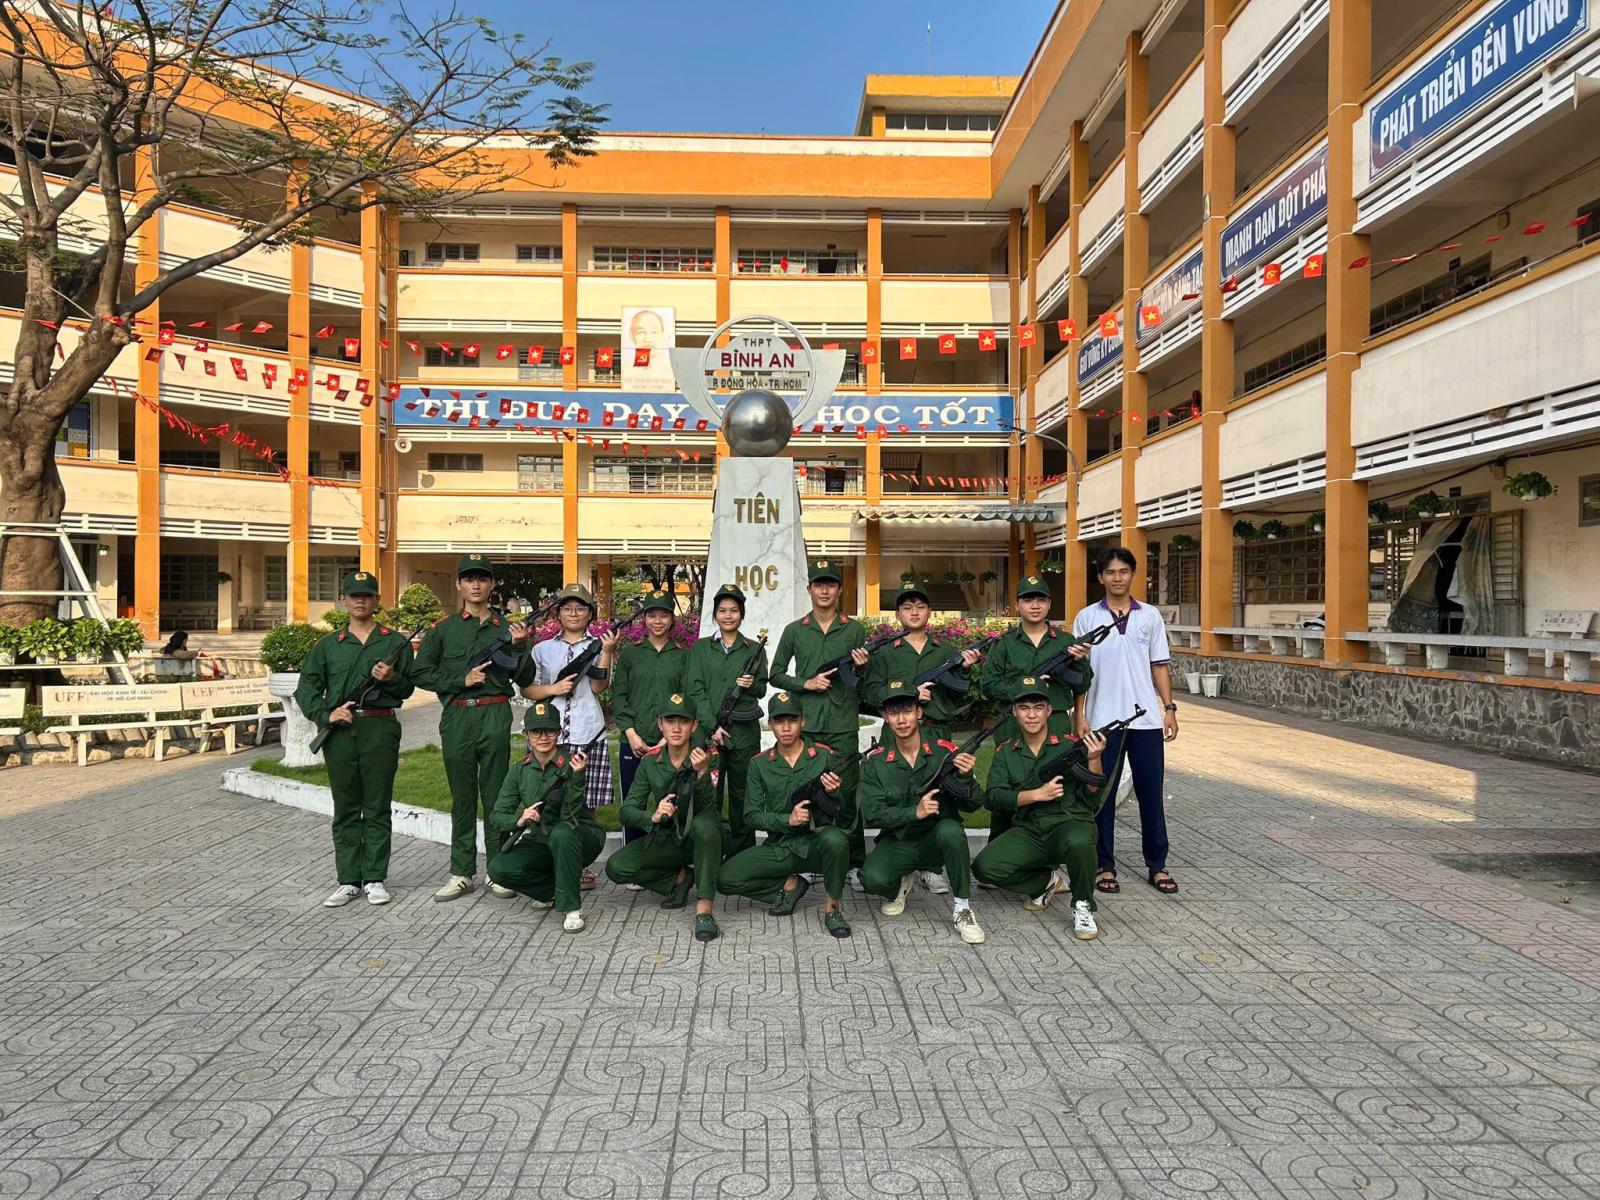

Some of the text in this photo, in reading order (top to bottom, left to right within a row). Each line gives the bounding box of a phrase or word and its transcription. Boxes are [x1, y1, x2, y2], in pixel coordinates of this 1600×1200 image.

[1380, 94, 1416, 153] PHÁT
[1420, 49, 1465, 123] TRIỂN
[1472, 23, 1506, 87] BỀN
[1226, 158, 1326, 267] MẠNH DẠN ĐỘT PHÁ
[743, 338, 772, 347] THPT
[721, 350, 794, 368] BÌNH AN
[416, 399, 489, 419] THI
[502, 401, 590, 420] ĐUA
[603, 402, 689, 427] DẠY
[913, 397, 994, 425] TỐT
[734, 491, 780, 523] TIÊN
[735, 565, 778, 597] HỌC
